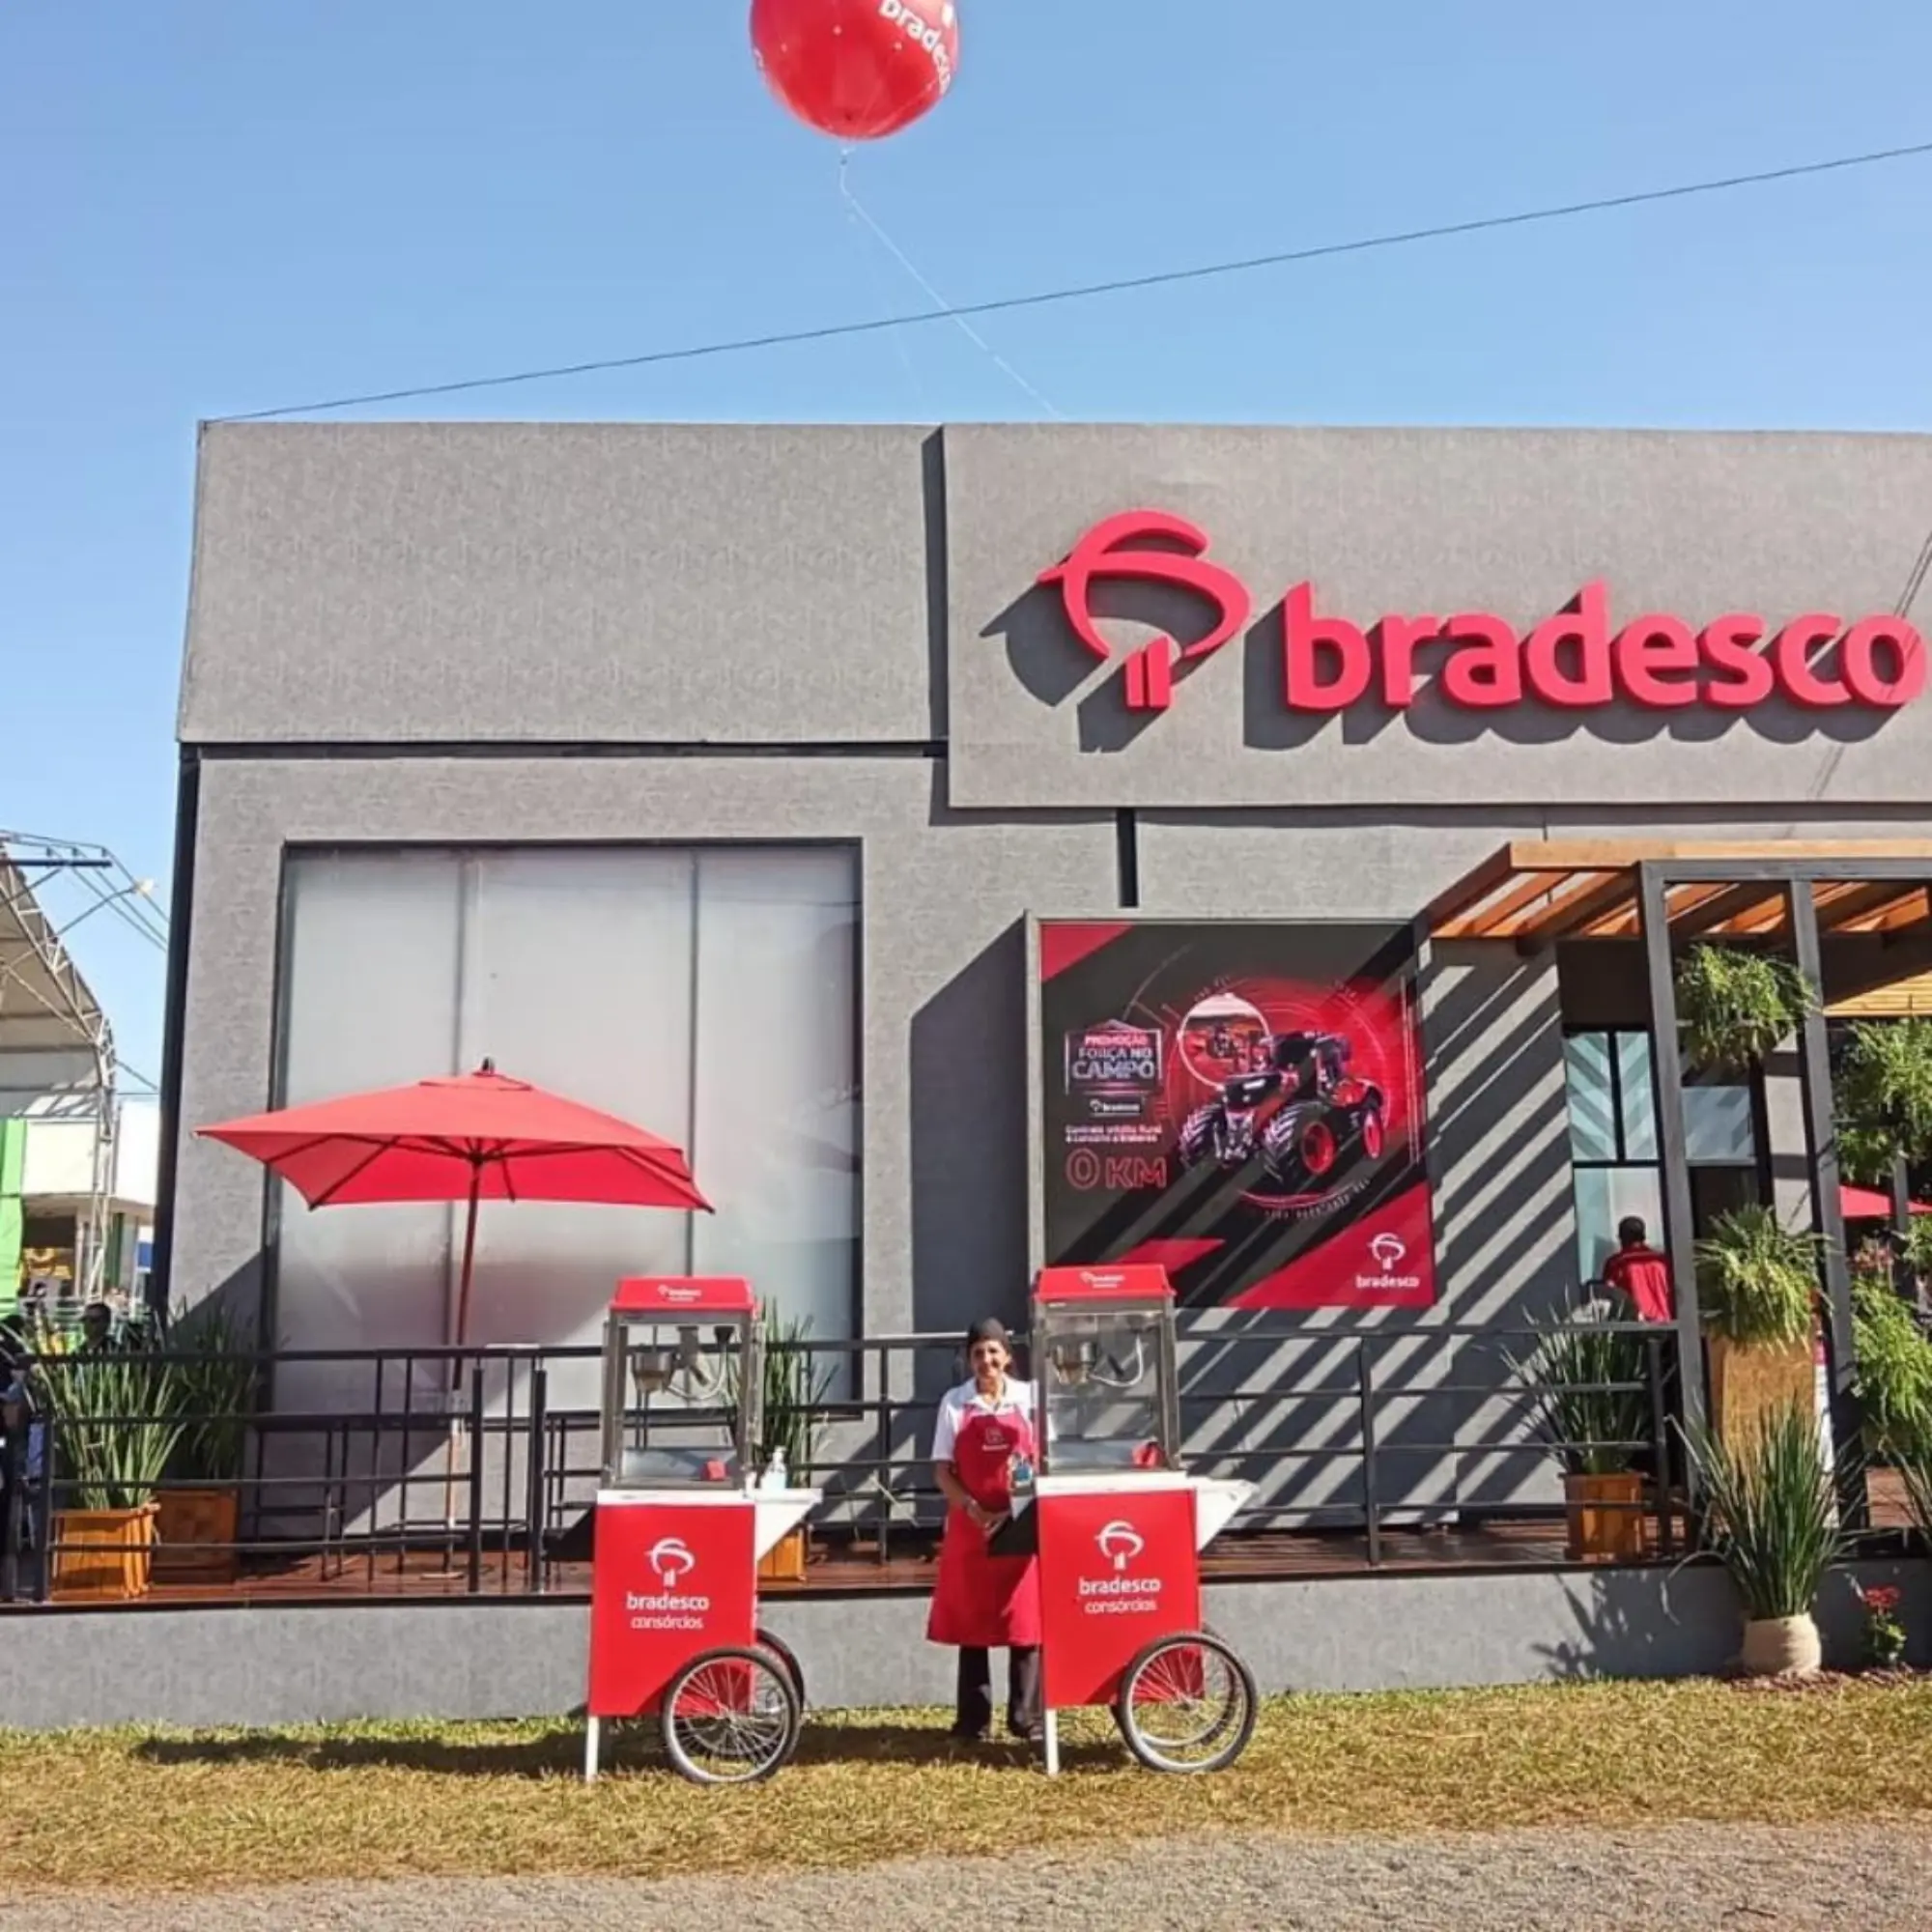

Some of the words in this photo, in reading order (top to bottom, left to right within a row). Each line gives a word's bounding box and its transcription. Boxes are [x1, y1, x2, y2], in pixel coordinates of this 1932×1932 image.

[1284, 575, 1928, 710] bradesco
[1072, 1061, 1154, 1079] CAMPO
[1105, 1156, 1167, 1188] KM
[1355, 1274, 1419, 1289] bradesco
[1079, 1575, 1161, 1596] bradesco
[626, 1590, 709, 1610] bradesco
[631, 1613, 704, 1630] consórcios
